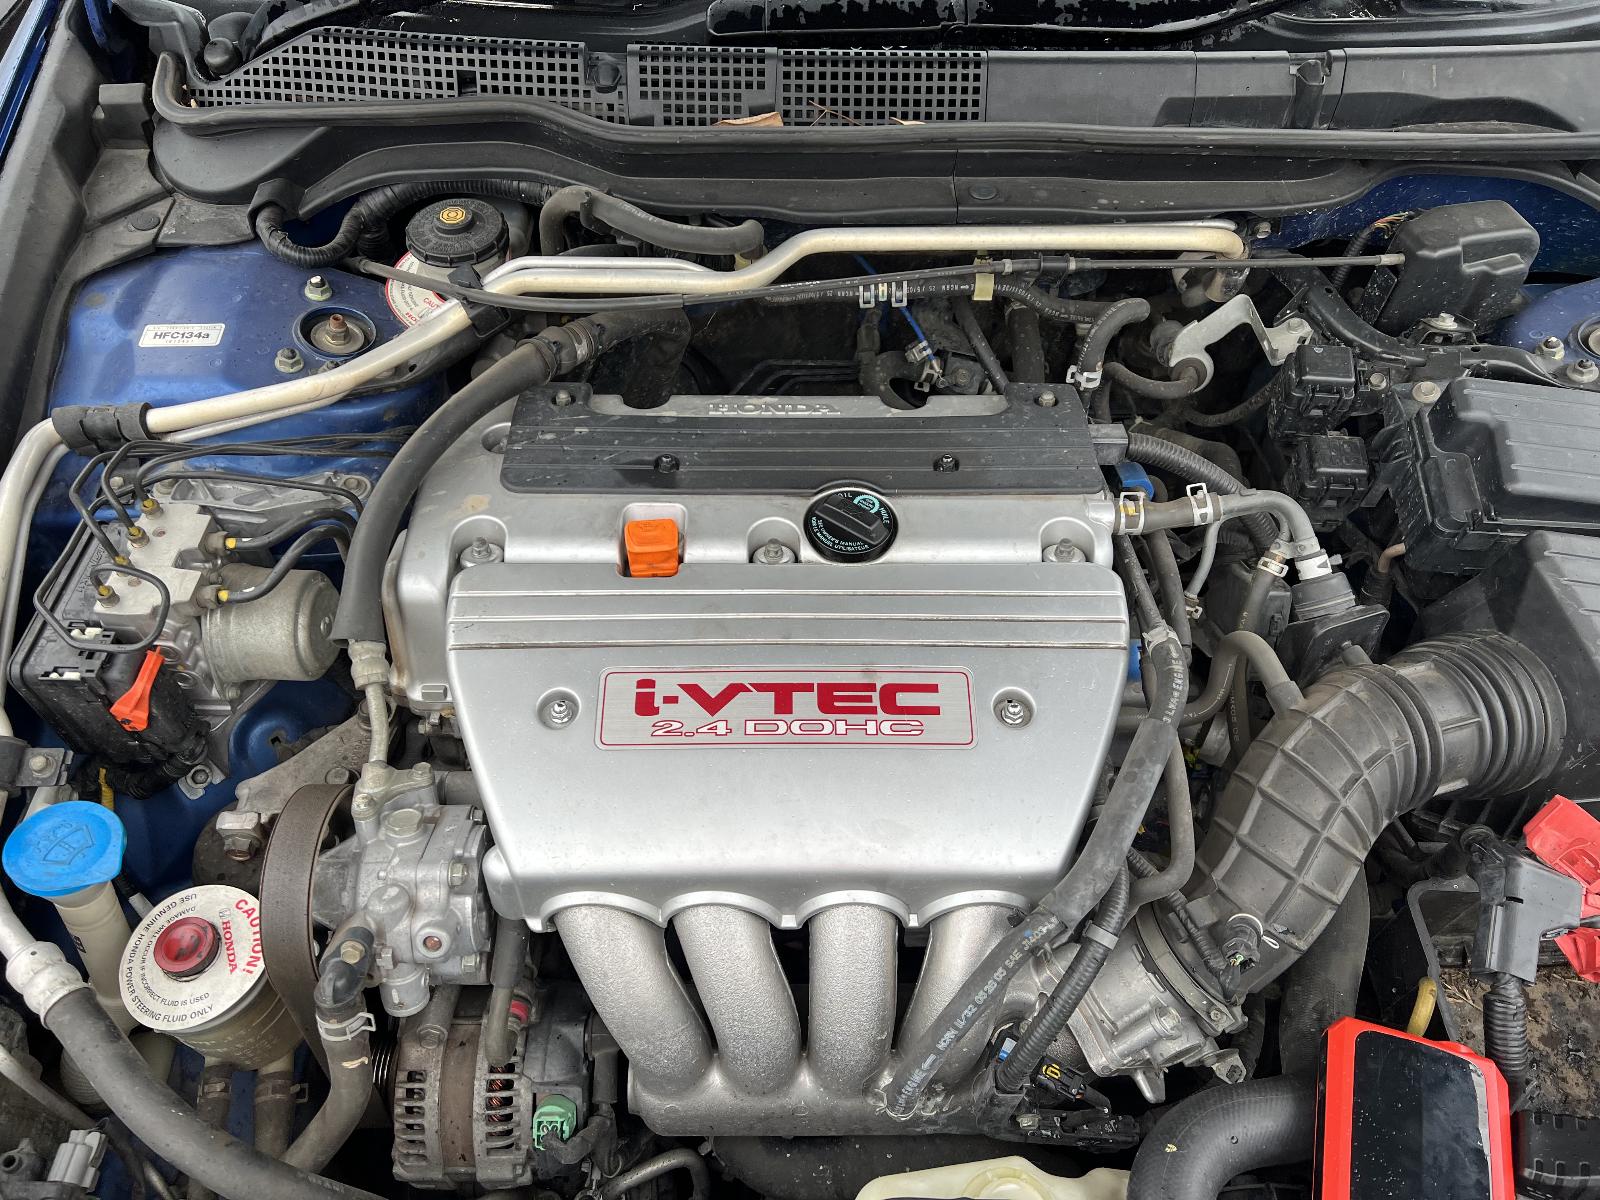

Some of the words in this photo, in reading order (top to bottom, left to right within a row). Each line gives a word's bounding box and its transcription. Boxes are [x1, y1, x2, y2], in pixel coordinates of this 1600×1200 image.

[153, 331, 210, 340] HFC134a
[708, 404, 841, 416] HONDA
[634, 678, 941, 717] i-VTEC
[650, 719, 733, 737] 2.4
[744, 719, 925, 737] DOHC
[179, 893, 198, 903] USE
[143, 901, 178, 932] GENUINE
[165, 905, 197, 924] DAMAGE
[152, 923, 166, 939] WILL
[235, 899, 262, 975] CAUTION!
[127, 933, 146, 964] HONDA
[141, 939, 154, 965] OCCUR
[222, 919, 238, 975] HONDA
[1004, 948, 1023, 969] SAE
[125, 966, 137, 996] POWER
[140, 972, 161, 1002] INCORRECT
[131, 995, 161, 1021] STEERING
[160, 996, 180, 1007] FLUID
[180, 999, 189, 1007] IS
[189, 992, 210, 1005] USED
[162, 1013, 188, 1023] FLUID
[189, 1003, 214, 1019] ONLY
